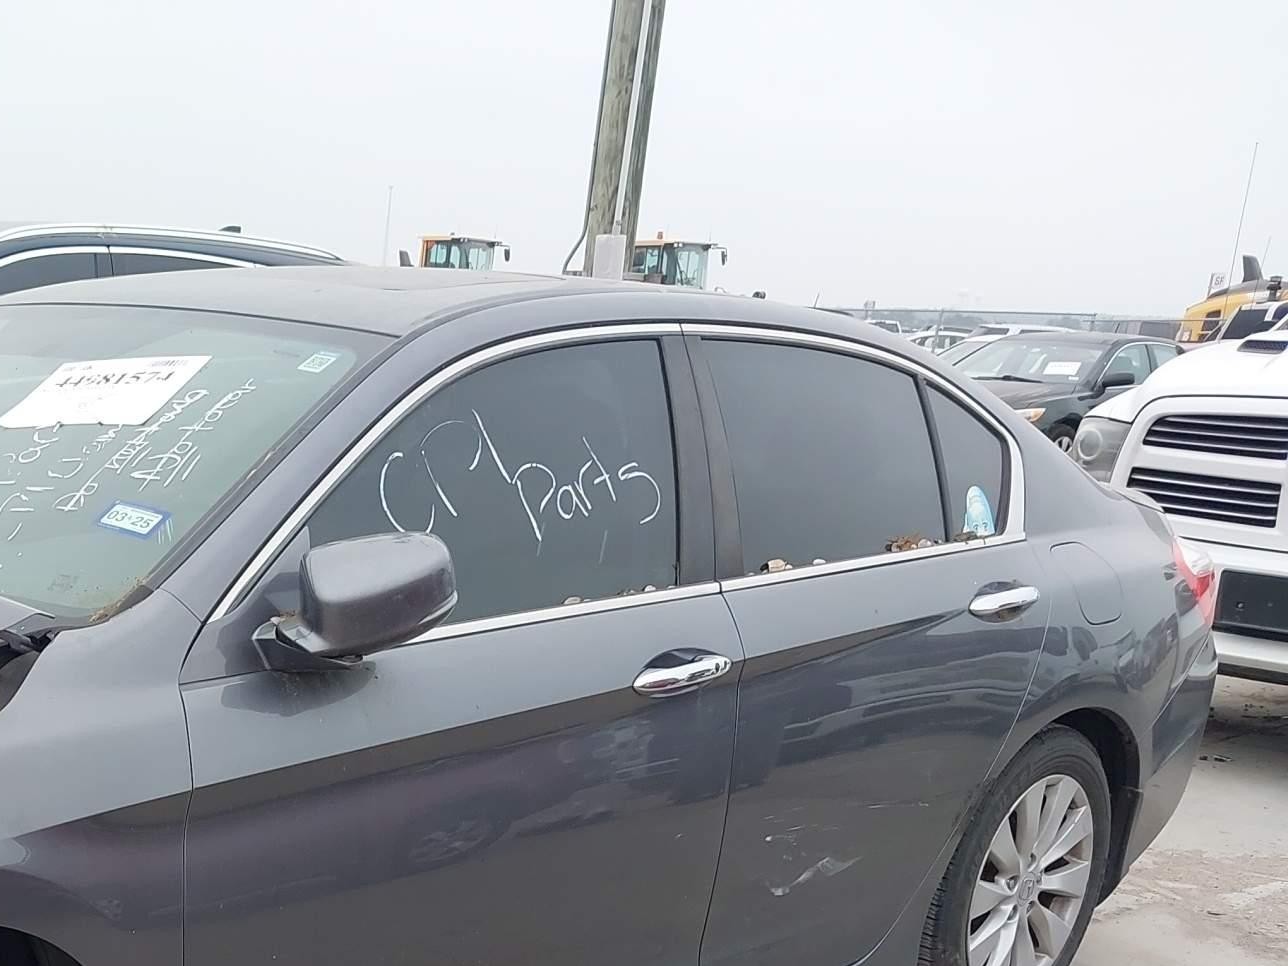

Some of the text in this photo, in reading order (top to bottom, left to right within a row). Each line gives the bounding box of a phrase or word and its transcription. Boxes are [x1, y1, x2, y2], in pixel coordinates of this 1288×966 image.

[55, 371, 176, 388] 44981574
[511, 436, 661, 542] Parts
[106, 510, 154, 529] 03 25
